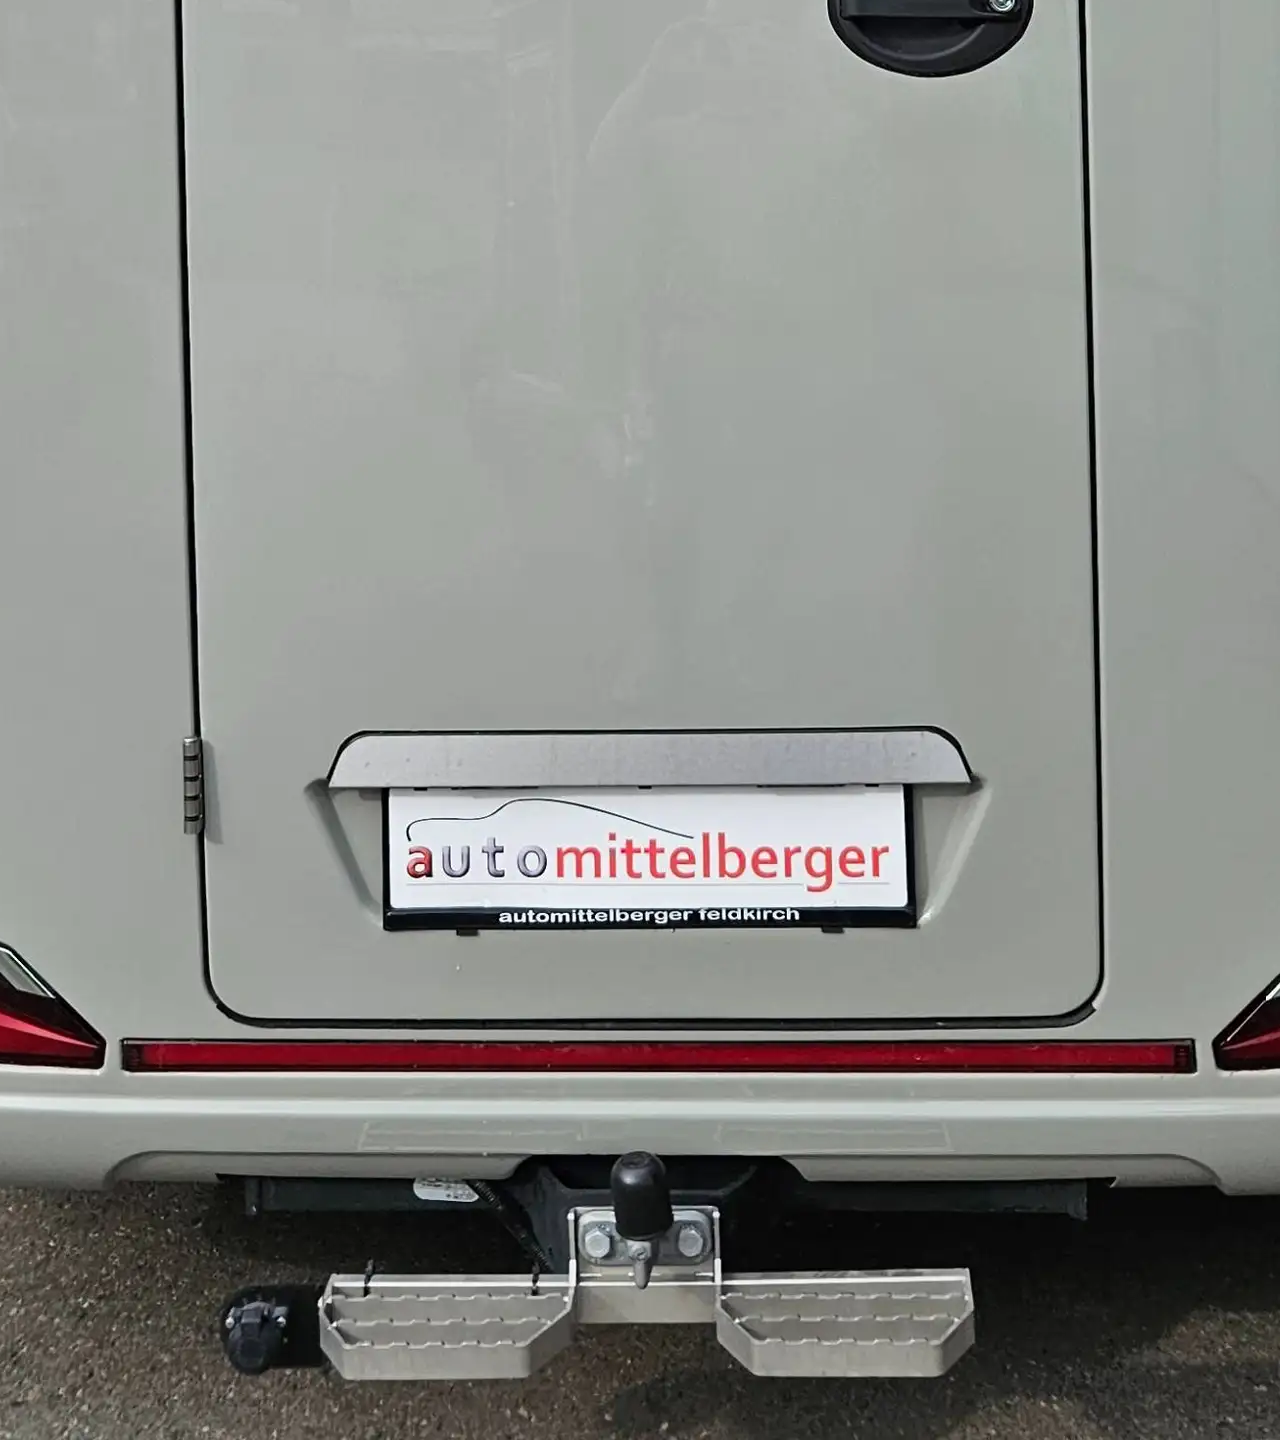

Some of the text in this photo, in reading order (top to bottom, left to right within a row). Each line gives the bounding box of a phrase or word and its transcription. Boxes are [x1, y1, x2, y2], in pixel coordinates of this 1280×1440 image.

[405, 831, 890, 893] automittelberger
[498, 905, 801, 924] automittelberger feldkirch
